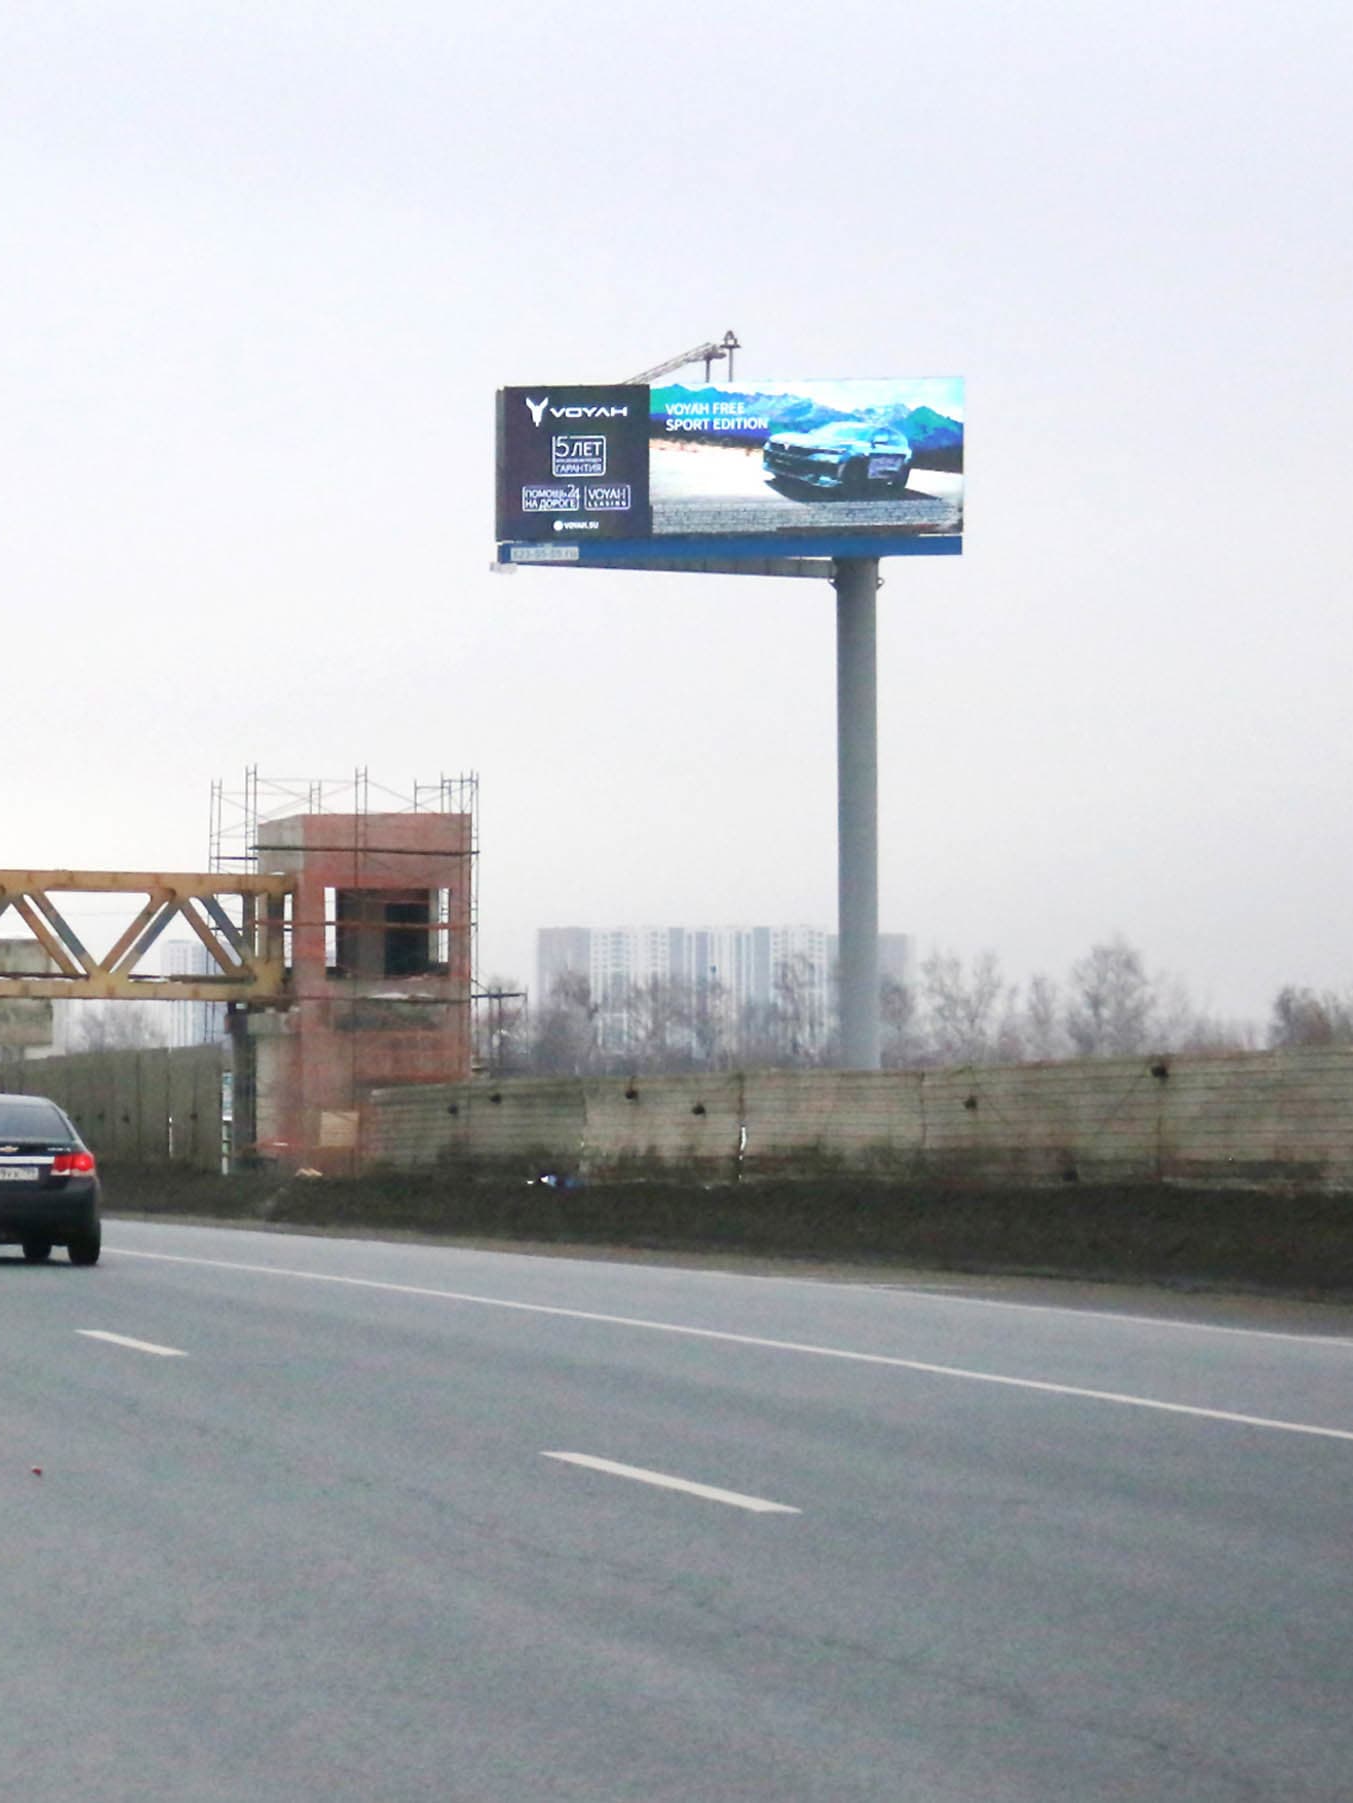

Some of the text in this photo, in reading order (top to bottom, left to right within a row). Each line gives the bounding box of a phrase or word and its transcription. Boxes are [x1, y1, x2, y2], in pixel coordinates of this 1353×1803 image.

[550, 407, 628, 417] VOYAH
[665, 402, 745, 415] VOYAH FREE
[665, 418, 769, 431] SPORT EDITION
[555, 436, 602, 457] 5 ЛЕТ
[555, 463, 602, 473] ГАРАНТИЯ
[525, 488, 567, 498] ПОМОЩЬ
[588, 488, 626, 500] VOYAH
[525, 499, 575, 511] НА ДОРОГЕ
